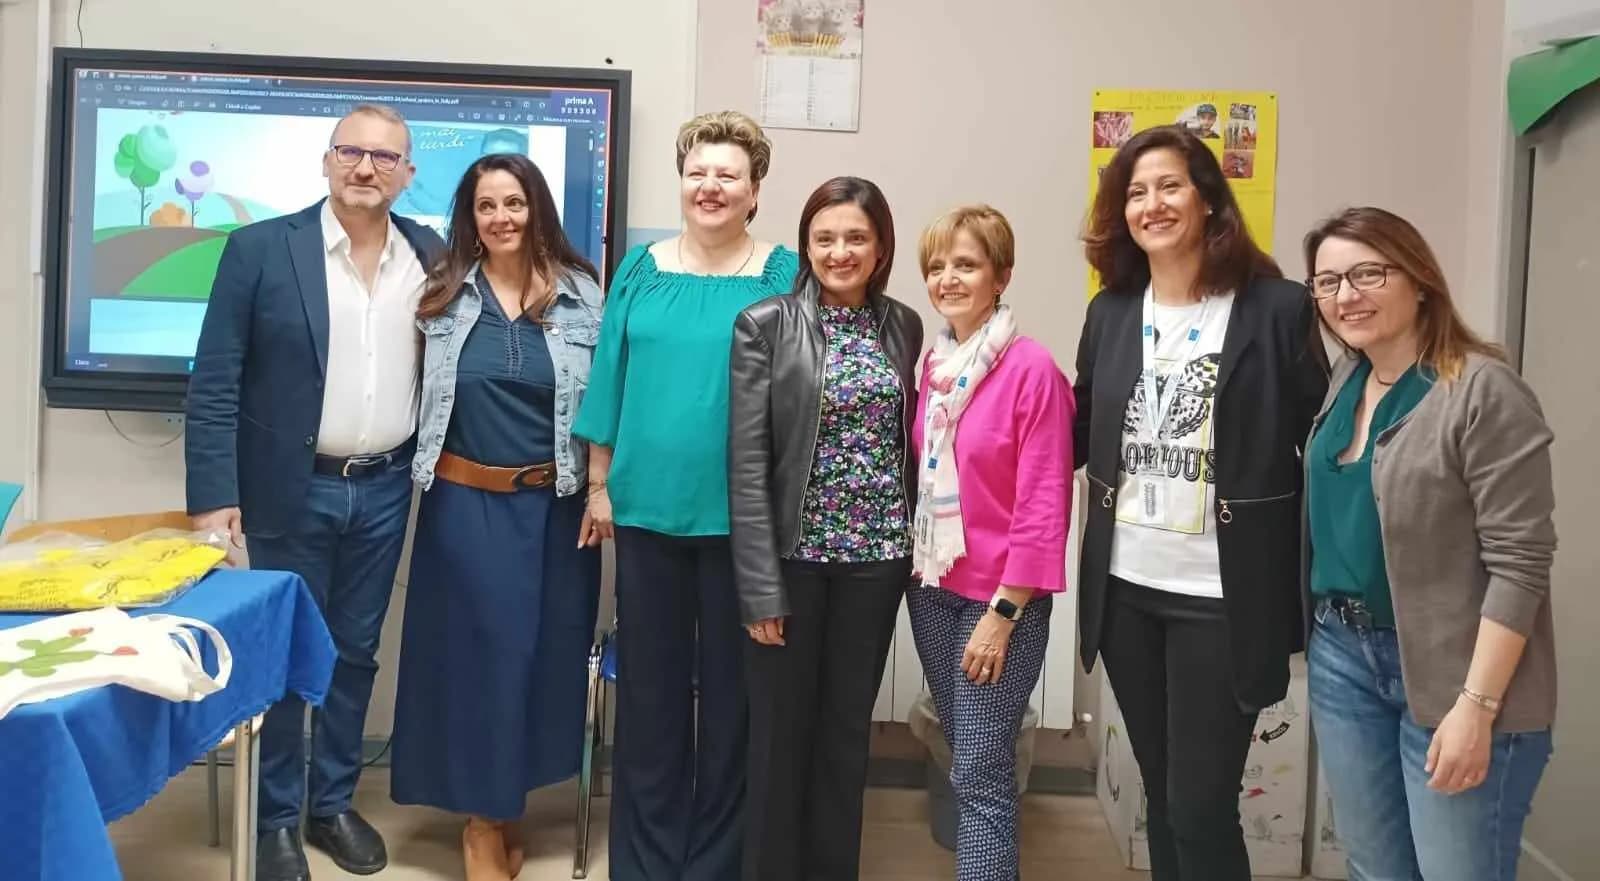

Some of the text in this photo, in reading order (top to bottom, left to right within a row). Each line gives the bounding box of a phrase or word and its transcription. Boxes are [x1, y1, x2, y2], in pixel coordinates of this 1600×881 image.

[565, 96, 594, 106] prima A
[1120, 442, 1216, 485] ORIOUS
